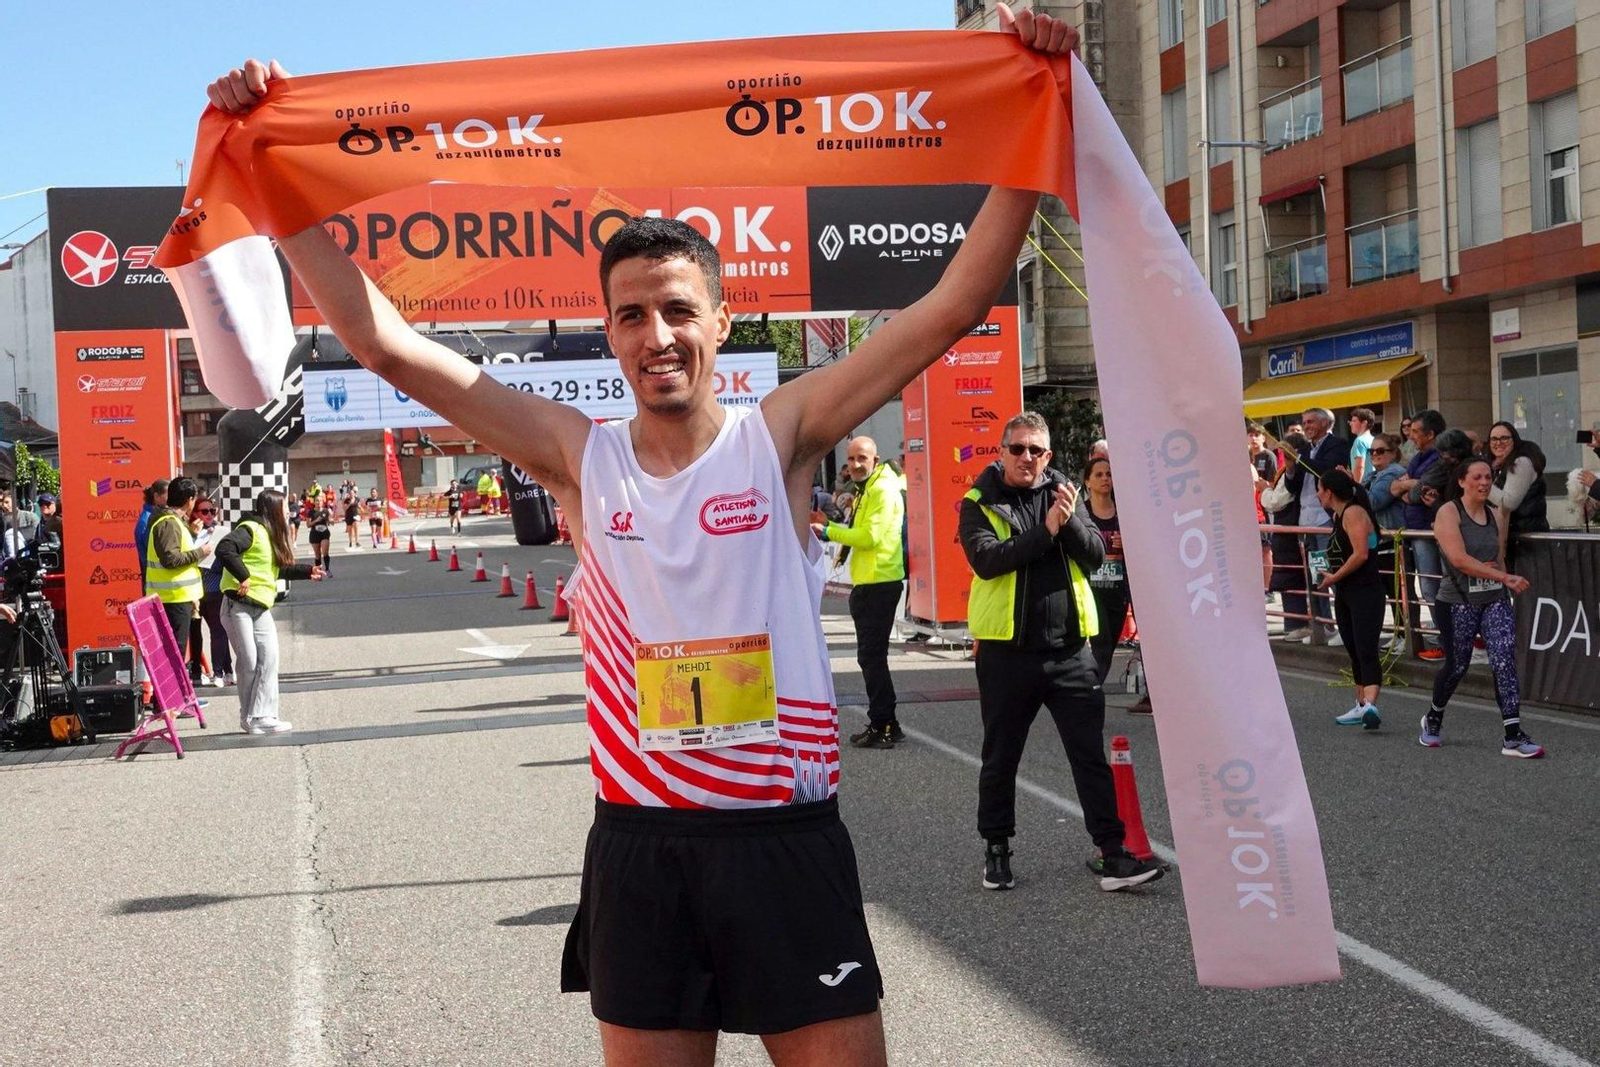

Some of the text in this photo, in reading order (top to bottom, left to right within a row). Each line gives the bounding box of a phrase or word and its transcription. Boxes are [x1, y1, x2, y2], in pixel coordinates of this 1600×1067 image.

[727, 72, 803, 92] oporriño
[335, 101, 410, 120] oporriño
[817, 135, 943, 151] dezquilómetros
[849, 223, 967, 246] RODOSA
[879, 249, 943, 260] ALPINE
[124, 273, 171, 285] ESTACIO
[503, 286, 545, 309] 10K
[550, 290, 598, 308] máis
[721, 286, 759, 304] licia
[88, 348, 129, 356] RODOSA
[1269, 348, 1298, 376] Carril
[91, 404, 135, 418] FROIZ
[114, 479, 142, 489] GIA
[515, 488, 539, 501] DARE
[713, 499, 757, 513] ATLETISMO
[715, 513, 757, 527] SANTIAGO
[1530, 597, 1600, 657] DA
[677, 661, 712, 673] MEHDI
[690, 677, 703, 725] 1
